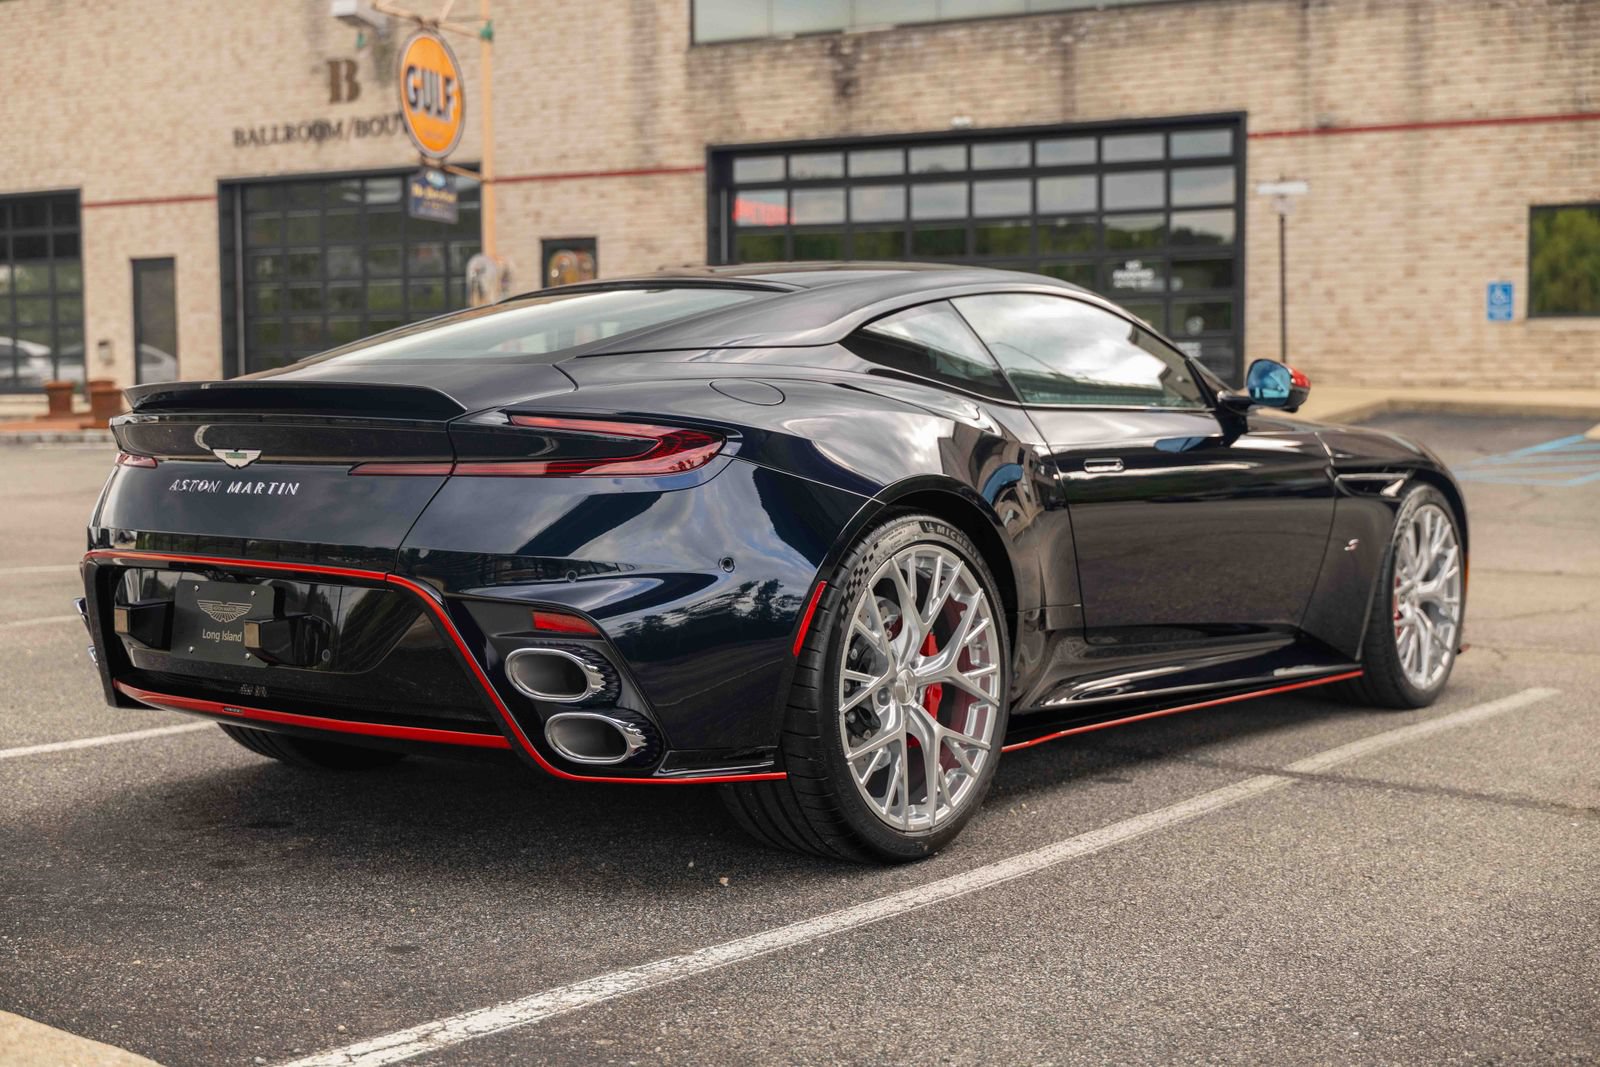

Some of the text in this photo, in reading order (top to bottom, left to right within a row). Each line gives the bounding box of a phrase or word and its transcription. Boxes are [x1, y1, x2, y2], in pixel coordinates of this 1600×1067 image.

[327, 57, 361, 105] B
[405, 64, 455, 123] GULF
[168, 479, 300, 496] ASTON MARTIN
[202, 628, 243, 643] Long Island
